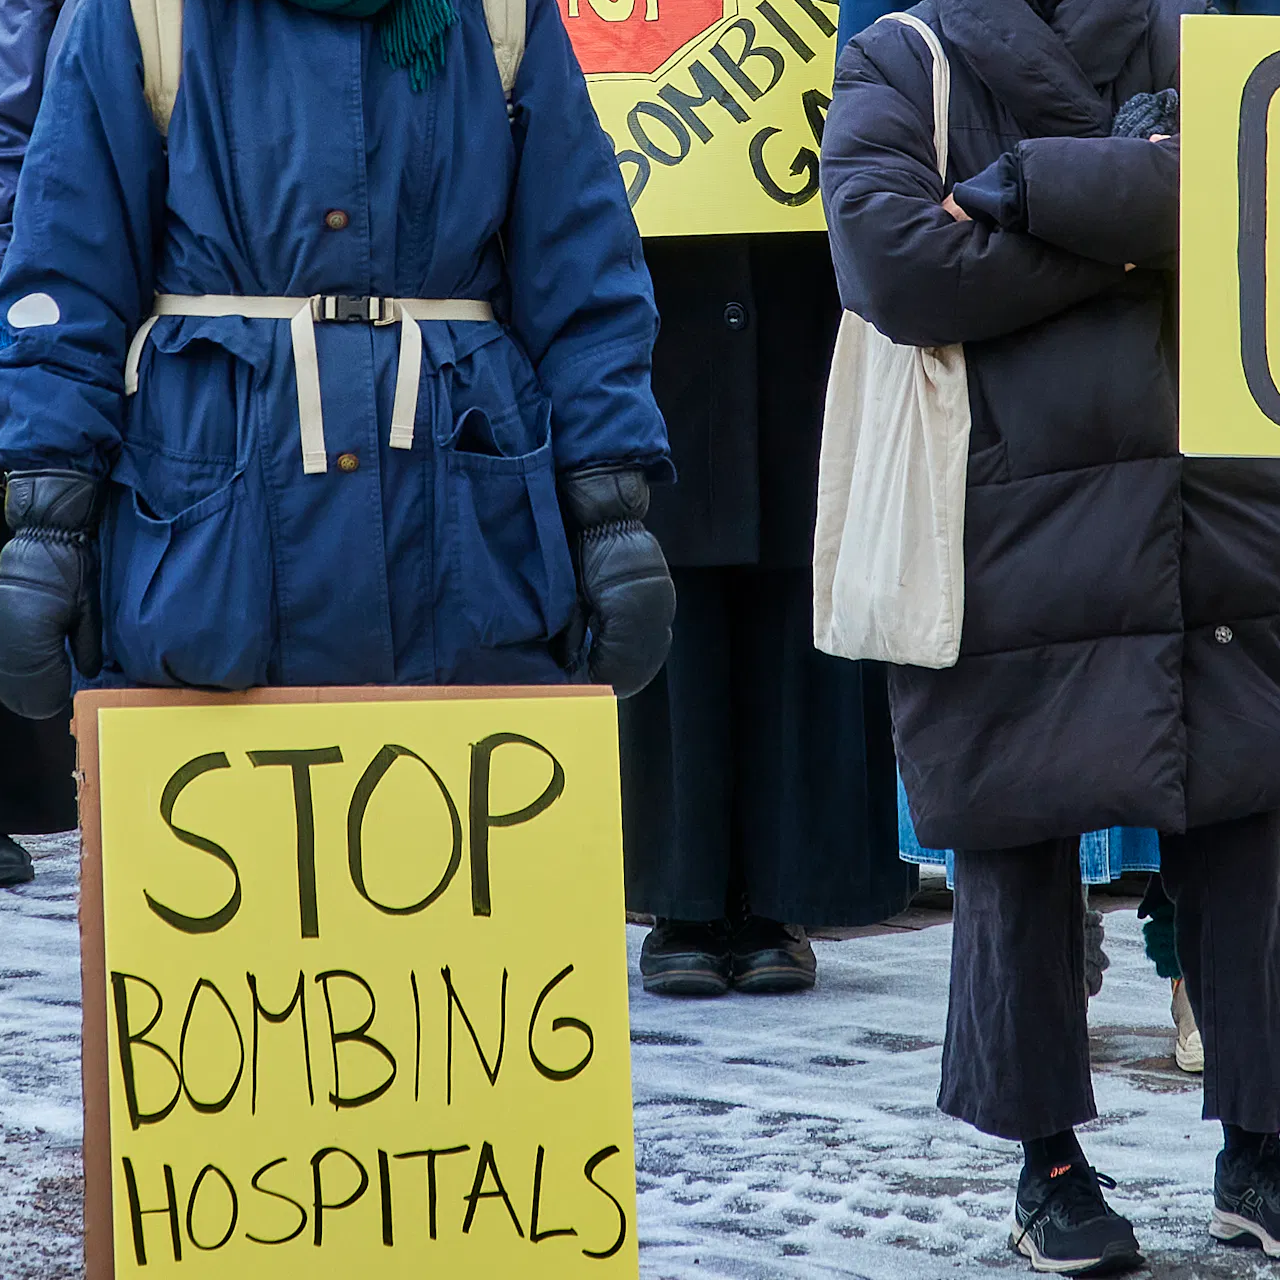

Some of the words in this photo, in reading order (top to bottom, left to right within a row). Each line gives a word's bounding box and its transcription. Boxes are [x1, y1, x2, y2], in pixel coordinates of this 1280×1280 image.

[143, 731, 565, 939] STOP
[111, 963, 595, 1131] BOMBING
[122, 1140, 627, 1266] HOSPITALS
